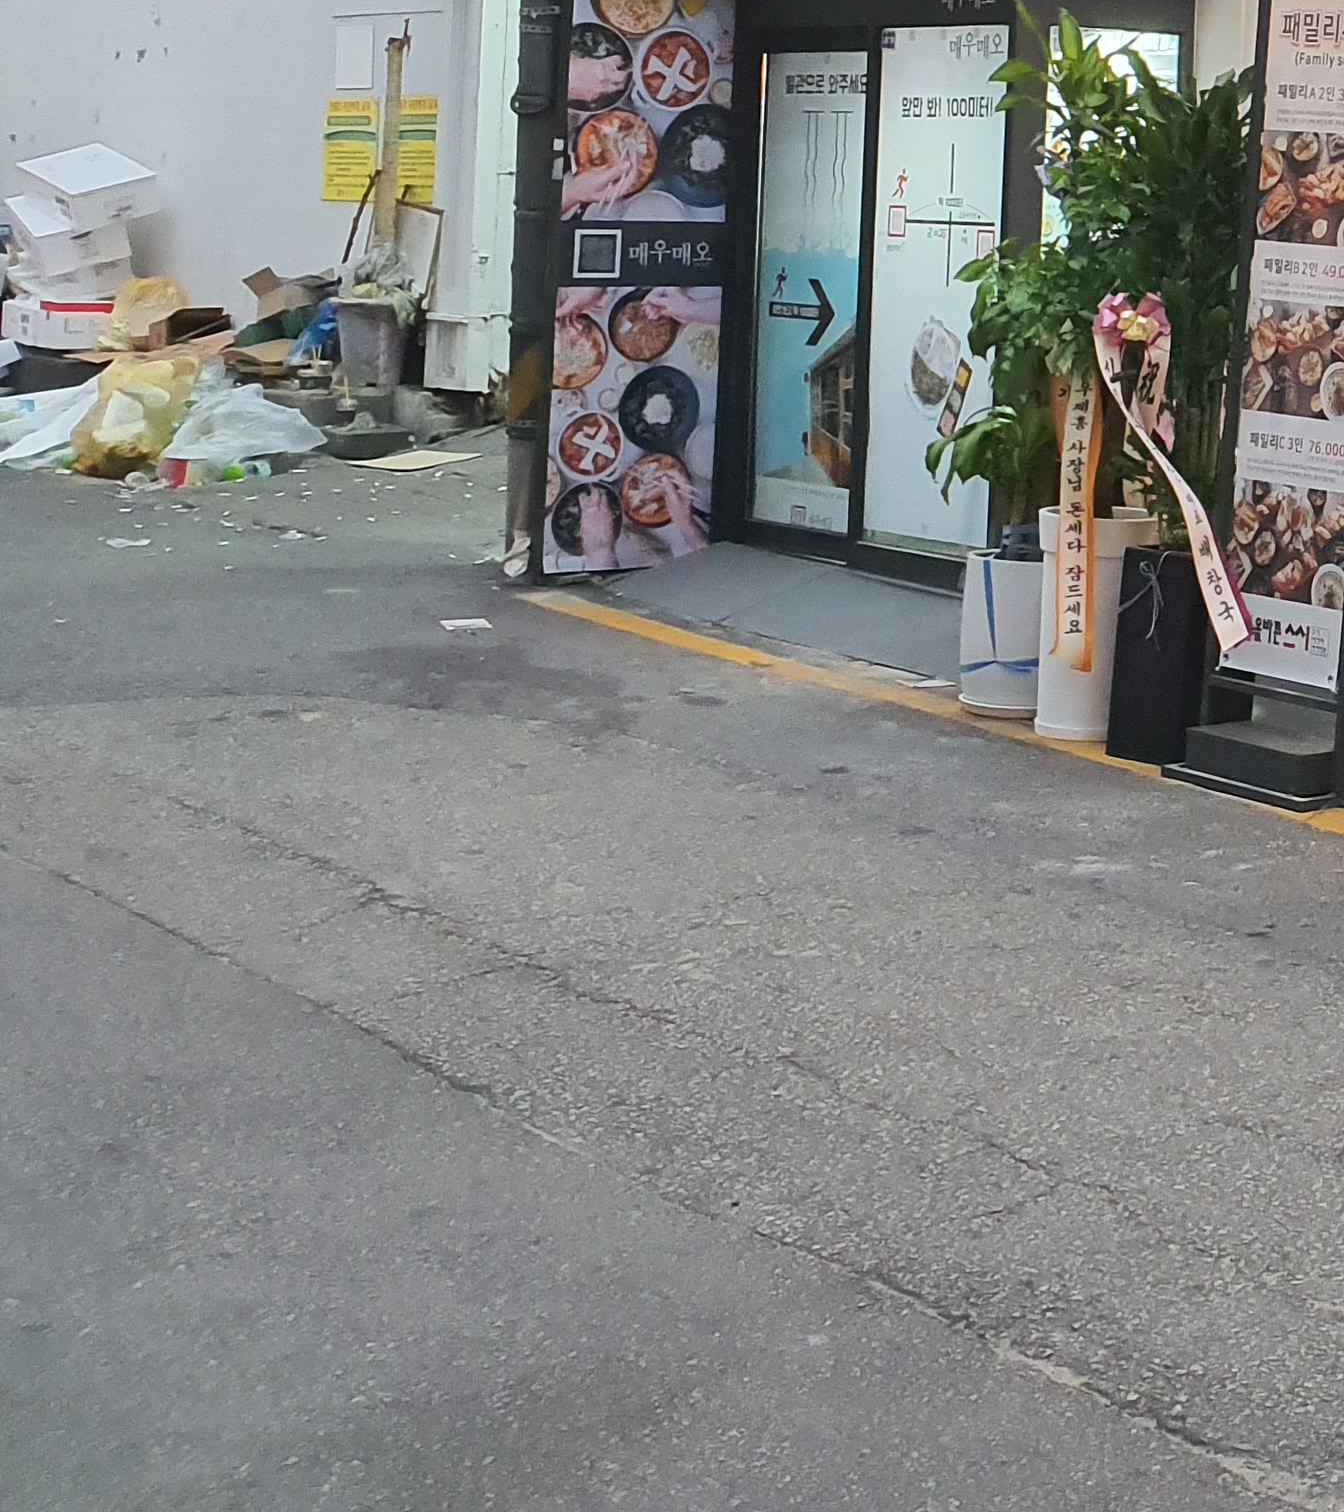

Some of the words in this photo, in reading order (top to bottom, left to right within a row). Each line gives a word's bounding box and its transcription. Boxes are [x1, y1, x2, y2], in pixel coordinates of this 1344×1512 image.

[949, 31, 1005, 60] 매우매오
[1294, 51, 1335, 70] (Family
[1318, 86, 1336, 103] 2인
[901, 96, 924, 118] 앞만
[946, 96, 995, 119] 100미터!
[628, 239, 714, 267] 매우매오
[1301, 260, 1319, 277] 2인
[1287, 435, 1304, 455] 3인
[1066, 439, 1087, 492] 사장님
[1064, 501, 1087, 555] 돈세다
[1062, 564, 1085, 636] 잠드세요
